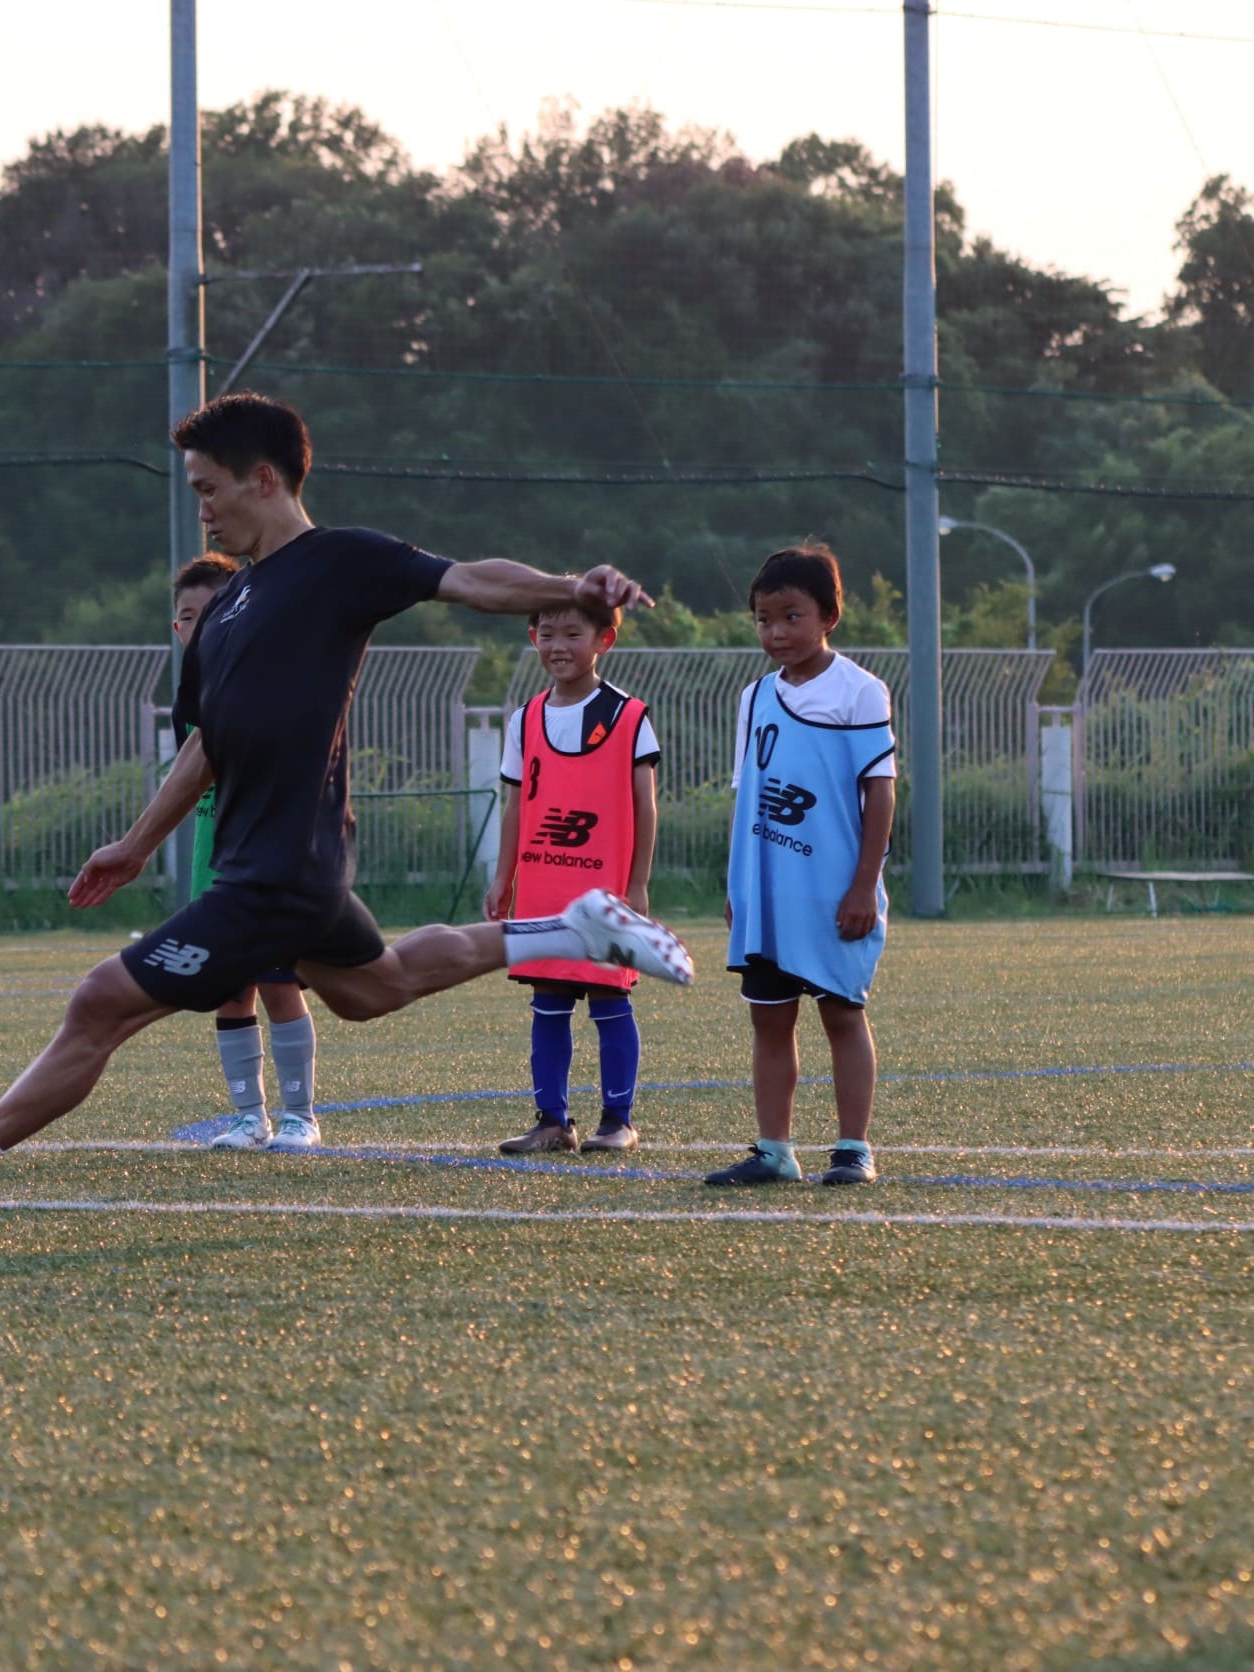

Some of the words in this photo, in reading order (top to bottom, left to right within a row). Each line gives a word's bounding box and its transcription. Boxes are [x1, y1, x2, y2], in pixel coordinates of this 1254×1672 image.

[755, 723, 779, 771] 10
[757, 777, 818, 826] NB
[529, 807, 599, 849] NB
[544, 851, 604, 870] balance
[143, 938, 210, 976] NB
